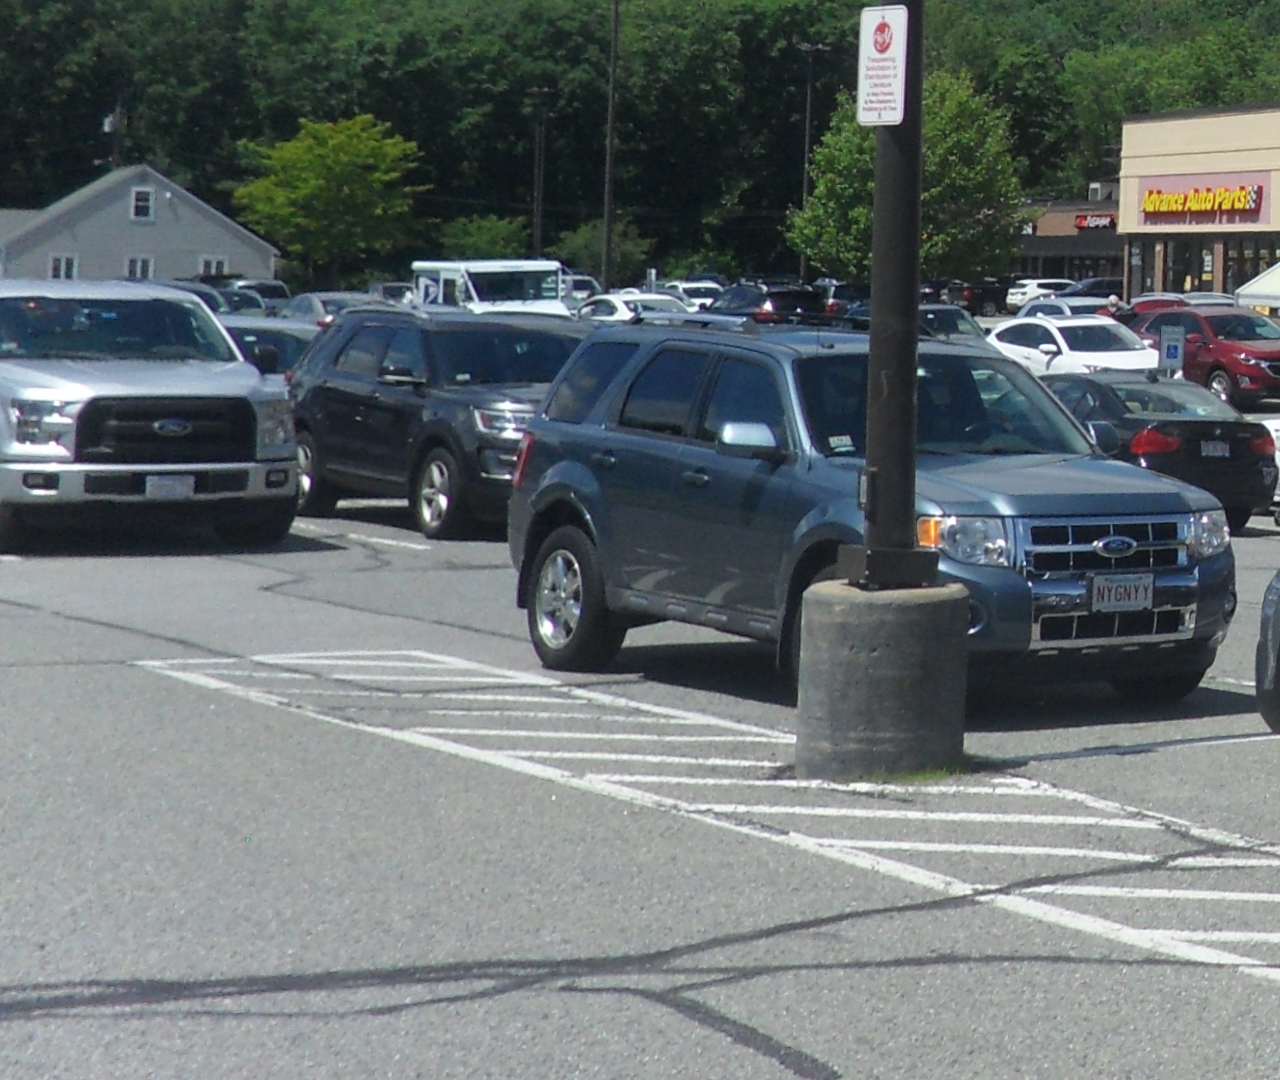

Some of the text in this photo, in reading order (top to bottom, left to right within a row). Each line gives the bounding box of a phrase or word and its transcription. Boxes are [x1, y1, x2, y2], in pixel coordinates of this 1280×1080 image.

[1140, 186, 1248, 212] Advance Auto Parts
[1096, 583, 1150, 603] NYGNYY
